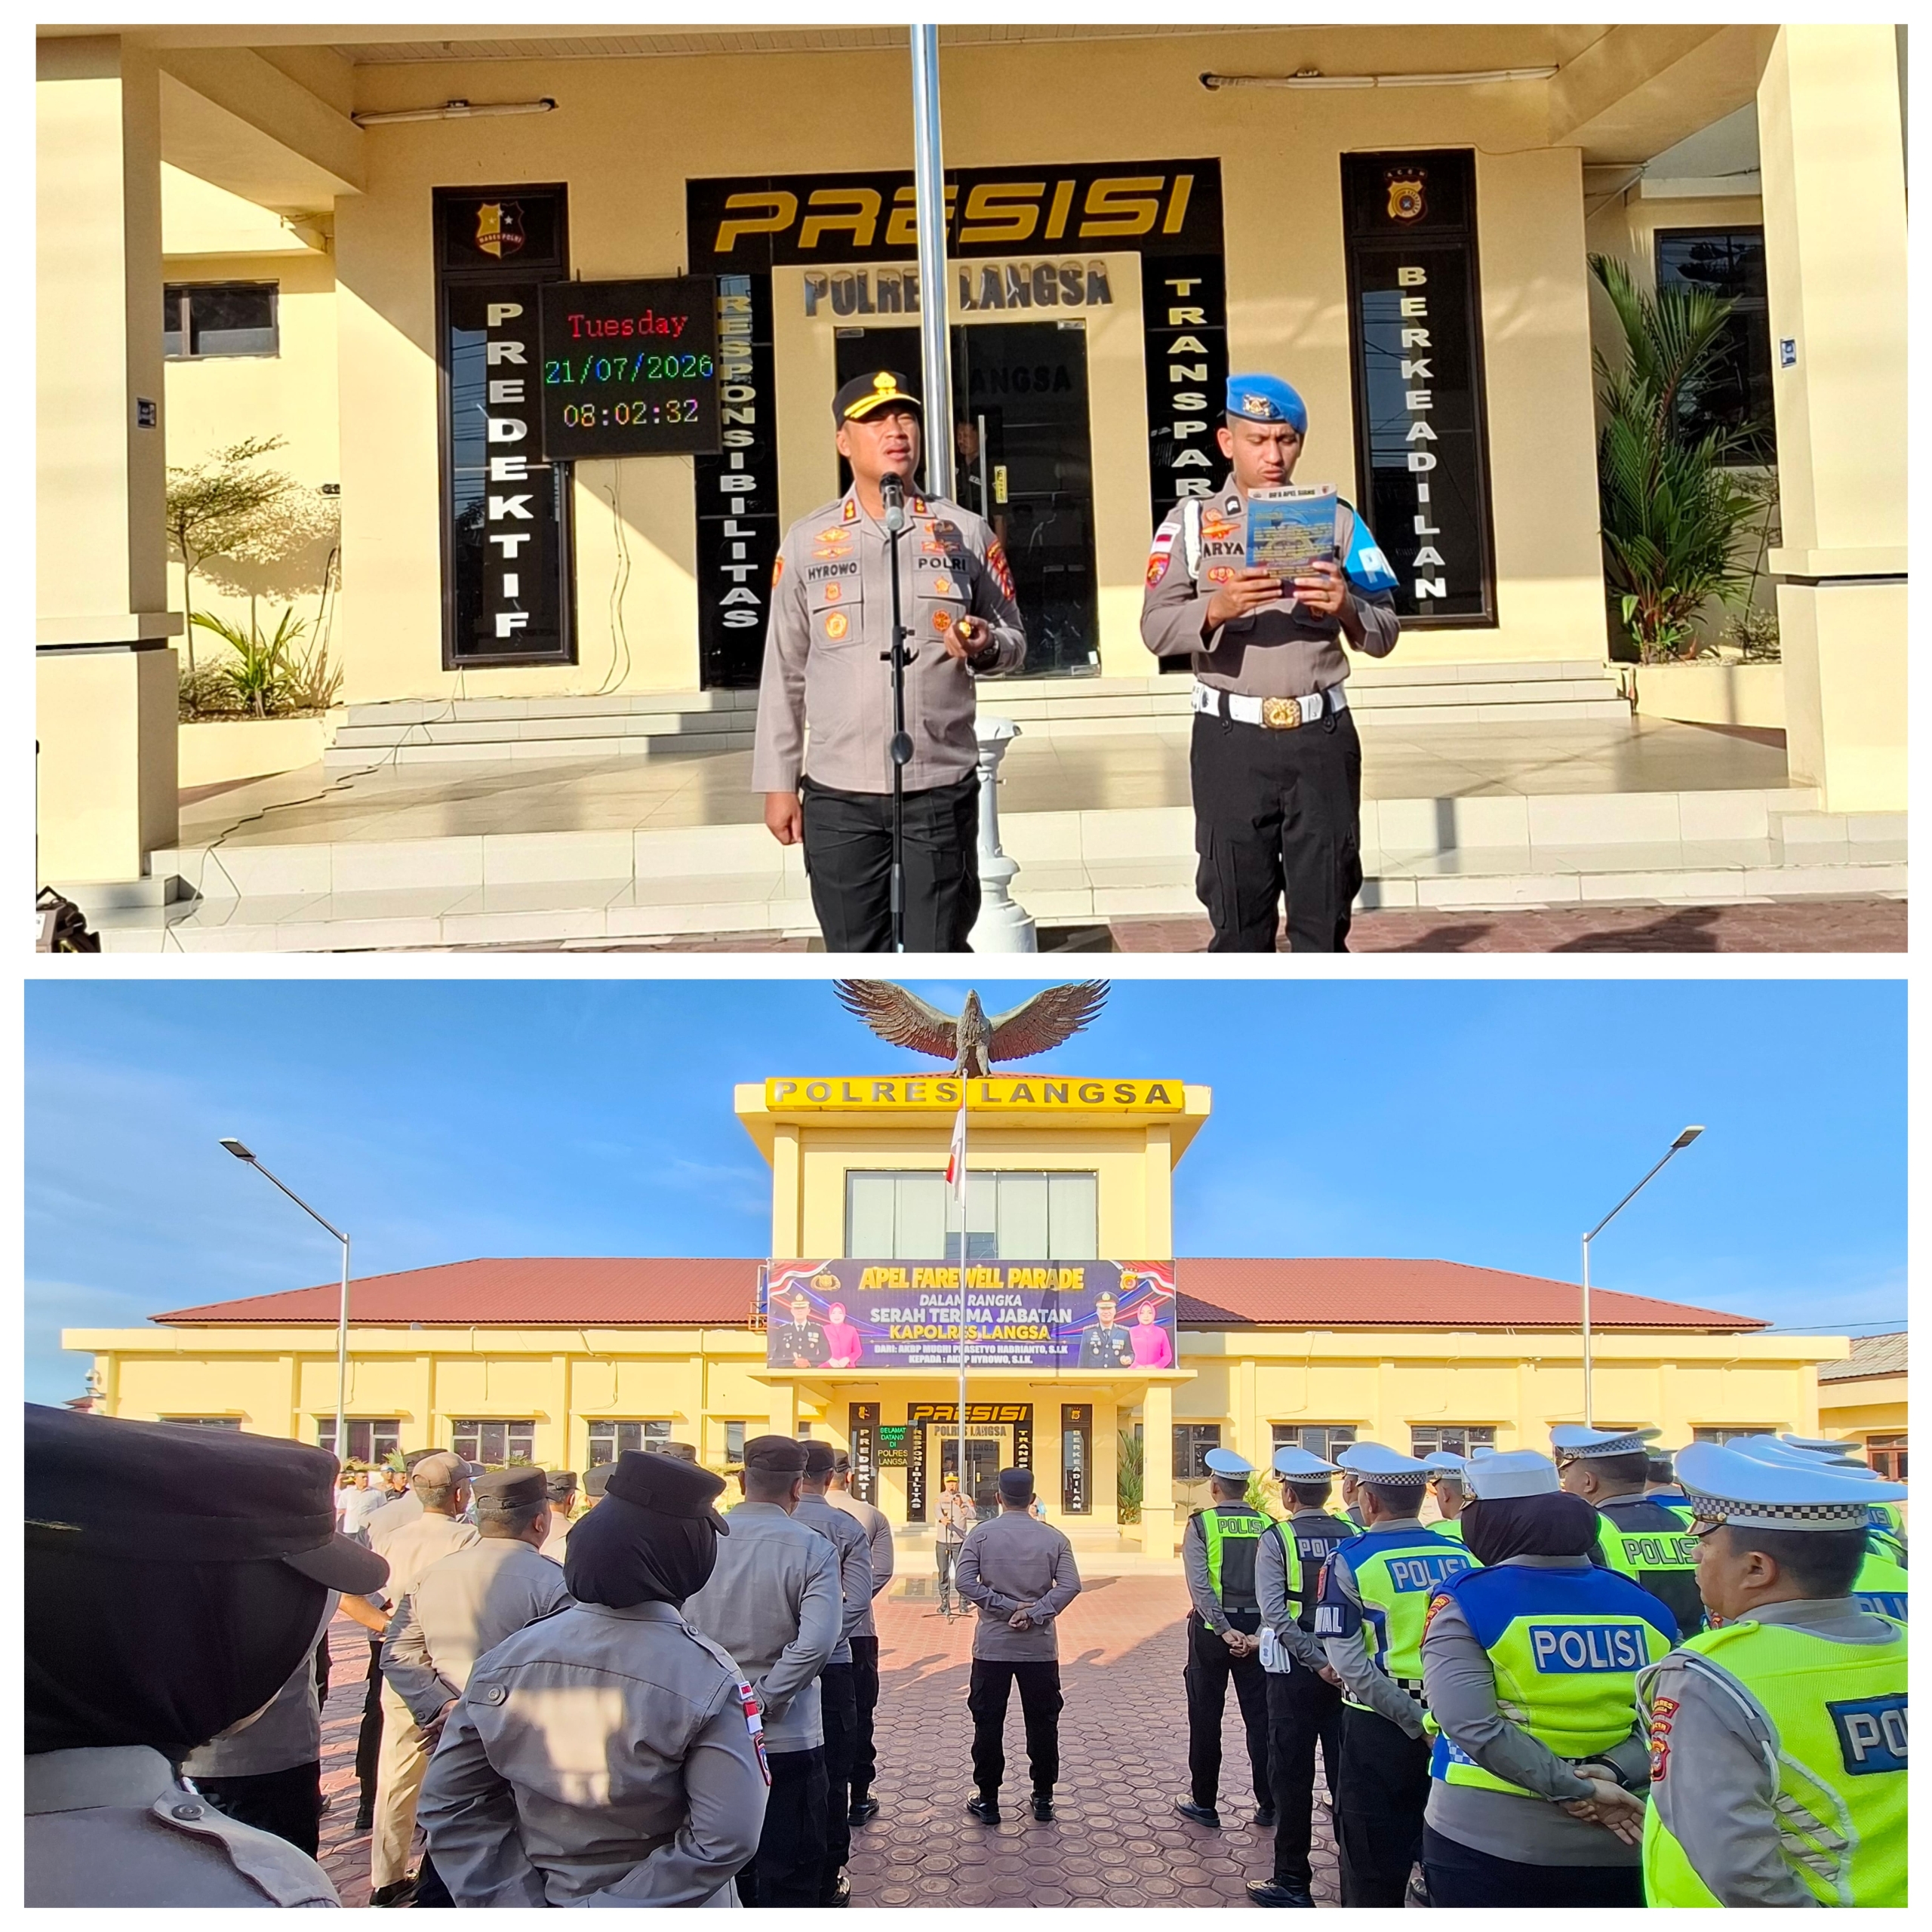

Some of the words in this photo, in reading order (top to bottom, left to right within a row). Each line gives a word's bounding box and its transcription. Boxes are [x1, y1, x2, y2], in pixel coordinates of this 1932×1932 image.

[715, 175, 1194, 252] PRESISI
[804, 268, 921, 318] POLRE
[960, 260, 1113, 311] LANGSA
[568, 310, 688, 338] Tuesday
[546, 352, 714, 385] 21/07/2026
[1164, 278, 1214, 497] TRANSPAR
[564, 398, 699, 428] 08:02:32
[1398, 267, 1447, 599] BERKEADILAN
[487, 303, 534, 638] PREDEKTIF
[716, 297, 761, 628] RESPONSIBILITAS
[808, 562, 858, 577] HYROWO
[918, 558, 967, 571] POLRI
[774, 1081, 958, 1103] POLRES
[981, 1082, 1172, 1105] LANGSA
[859, 1267, 909, 1289] APEL
[912, 1267, 1004, 1289] FAREWELL
[1008, 1267, 1084, 1289] PARADE
[968, 1294, 1022, 1306] RANGKA
[869, 1308, 926, 1323] SERAH
[929, 1308, 993, 1323] TERMA
[995, 1308, 1072, 1324] JABATAN
[981, 1324, 1051, 1340] LANGSA
[874, 1344, 898, 1353] DARI:
[898, 1344, 921, 1353] AKBP
[952, 1344, 996, 1354] PASETYO
[908, 1355, 942, 1364] KEPADA
[946, 1355, 970, 1364] AKP
[913, 1405, 1028, 1421] PRESISI
[970, 1426, 1007, 1437] LANGSA
[1017, 1430, 1029, 1469] TRANSP
[858, 1429, 870, 1503] PREDEKTI
[1072, 1430, 1081, 1509] BERKEADILAN
[1217, 1518, 1266, 1534] POLISI
[1620, 1537, 1700, 1565] POLIS
[1534, 1629, 1646, 1669] POLISI
[1844, 1708, 1908, 1761] PO
